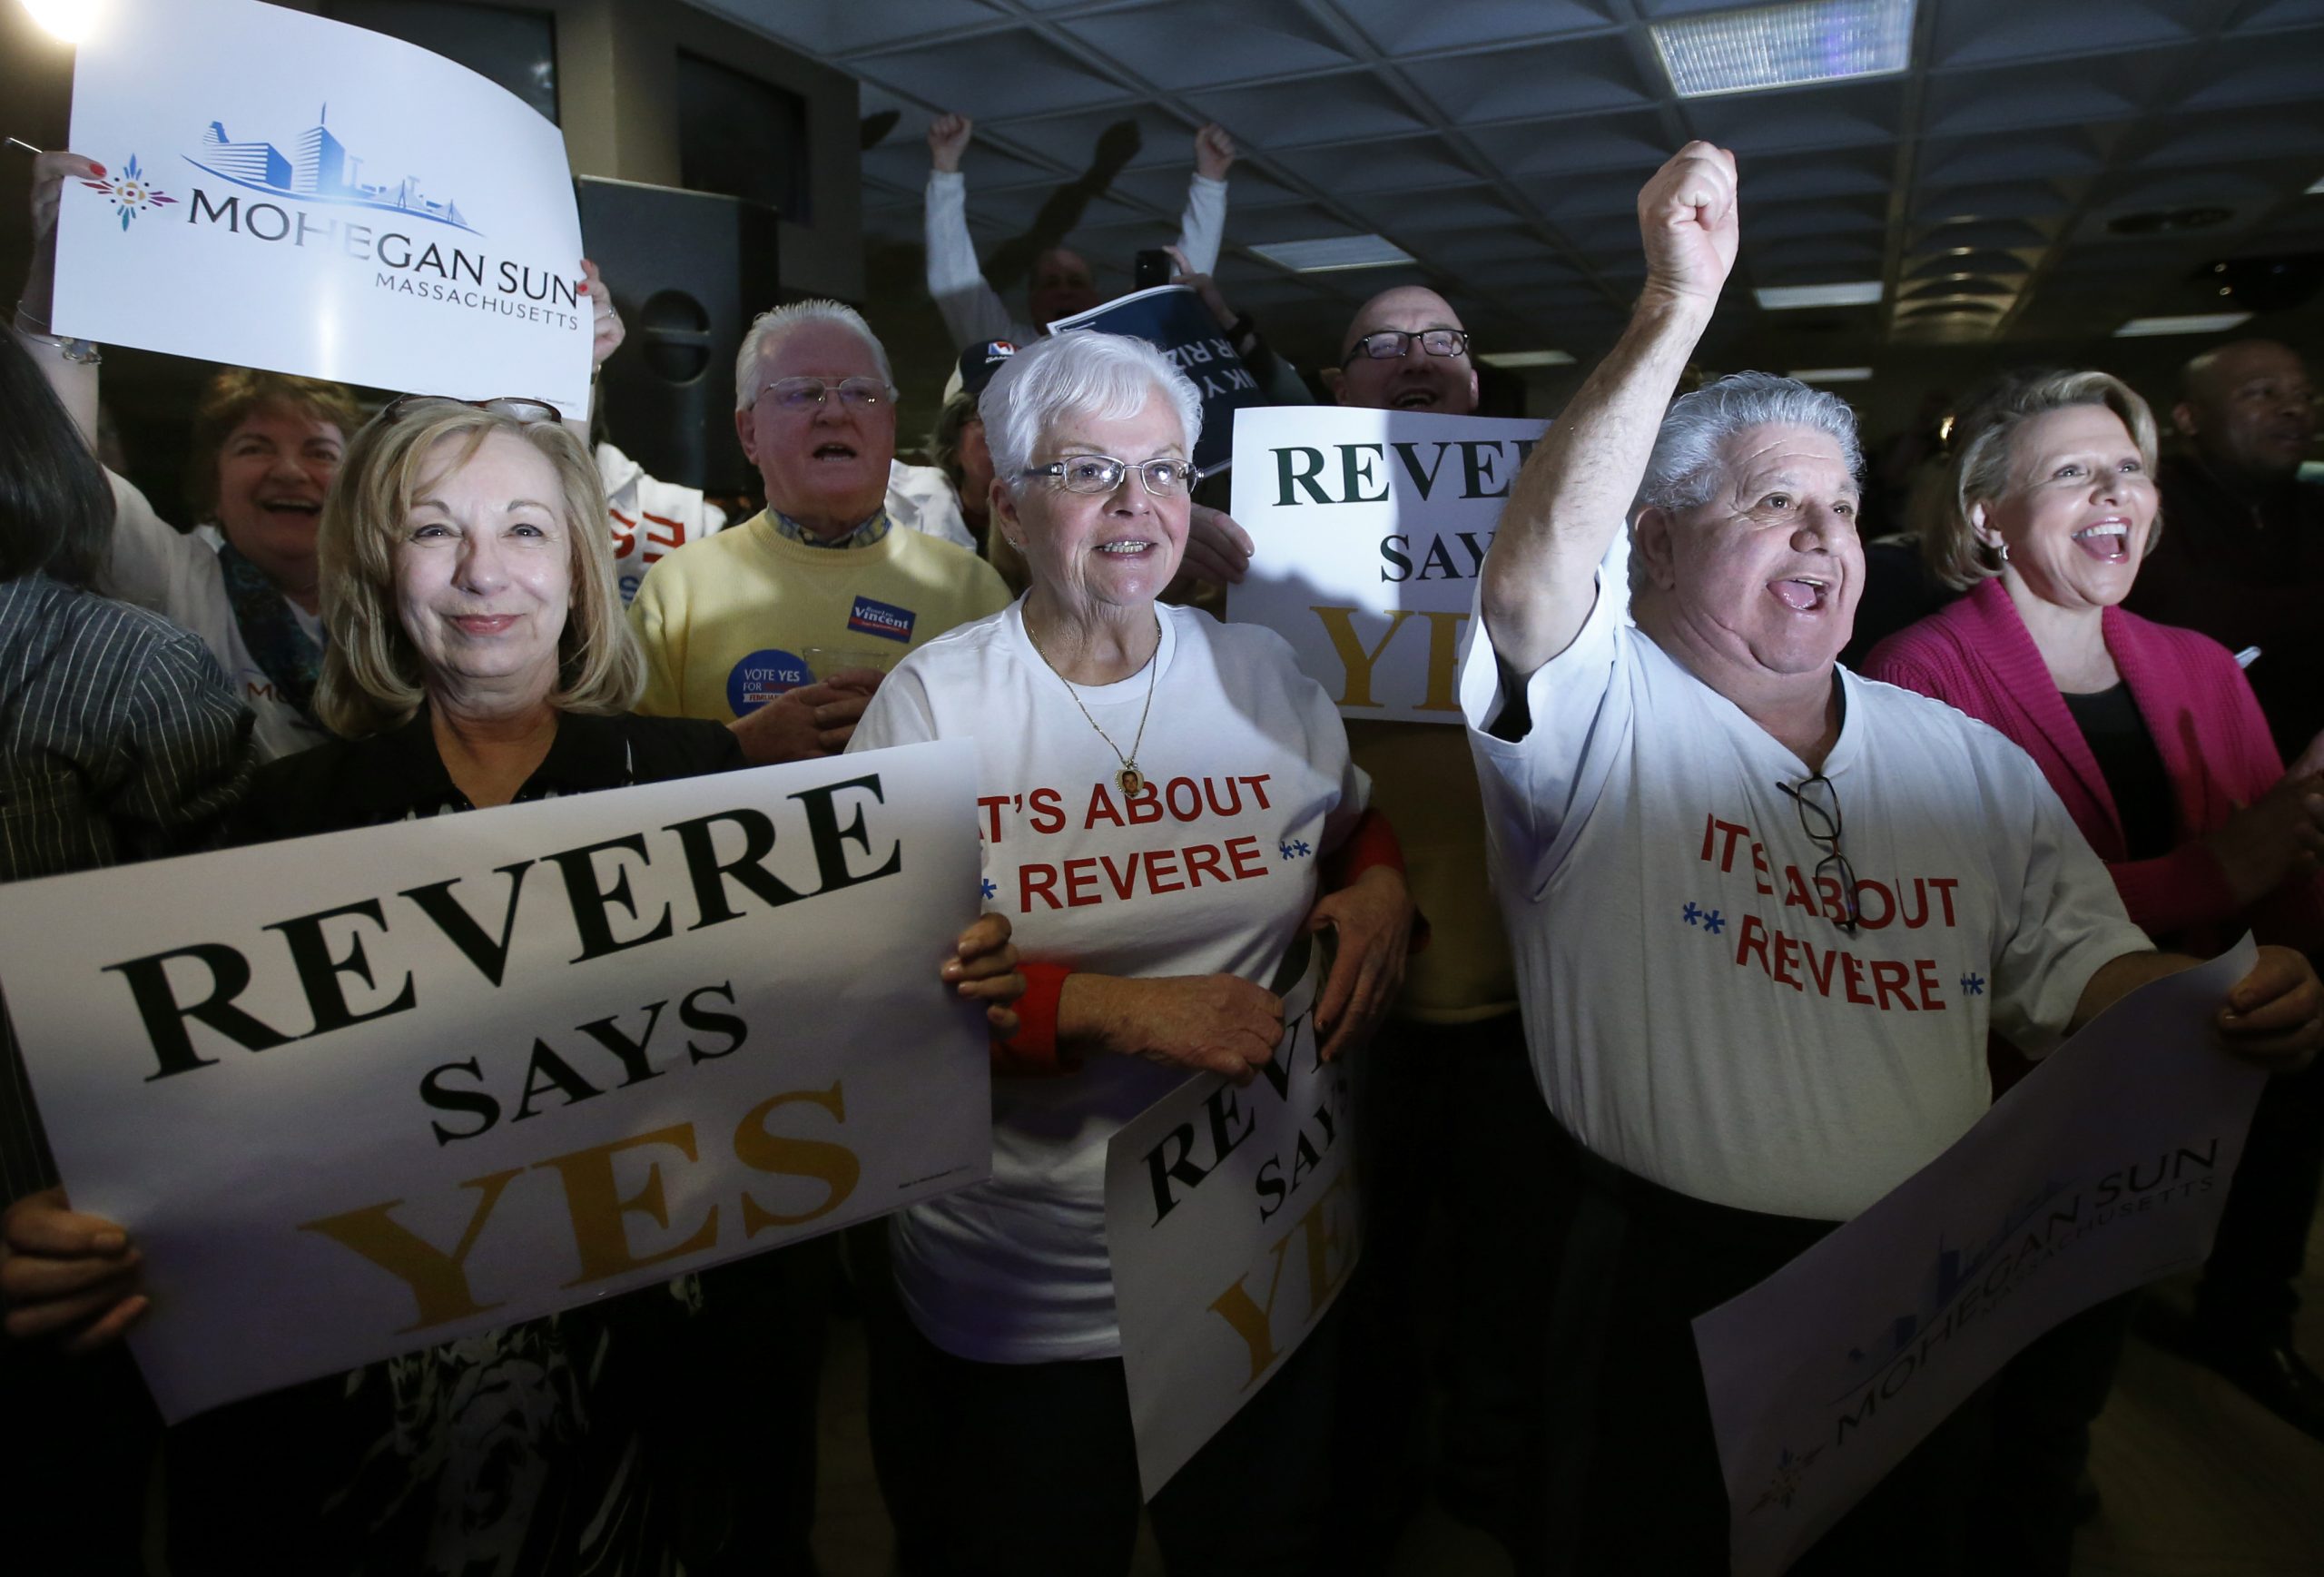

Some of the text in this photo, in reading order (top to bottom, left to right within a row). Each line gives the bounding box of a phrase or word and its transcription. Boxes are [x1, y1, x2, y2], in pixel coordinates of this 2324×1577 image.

[187, 188, 578, 310] MOHEGAN SUN
[376, 272, 578, 331] MASSACHUSETTS
[1268, 439, 1541, 506] REVE
[854, 606, 909, 630] Vincent
[743, 668, 801, 683] VOTE YES
[743, 682, 763, 692] FOR
[978, 774, 1271, 843] T'S ABOUT
[1019, 835, 1269, 913] REVERE
[1785, 865, 1959, 931] ABOUT
[101, 773, 902, 1083] REVERE
[1736, 913, 1946, 1011] REVERE
[419, 981, 749, 1148] SAYS
[297, 1079, 862, 1336] YES
[1836, 1138, 2220, 1445] MOHEGAN SUN
